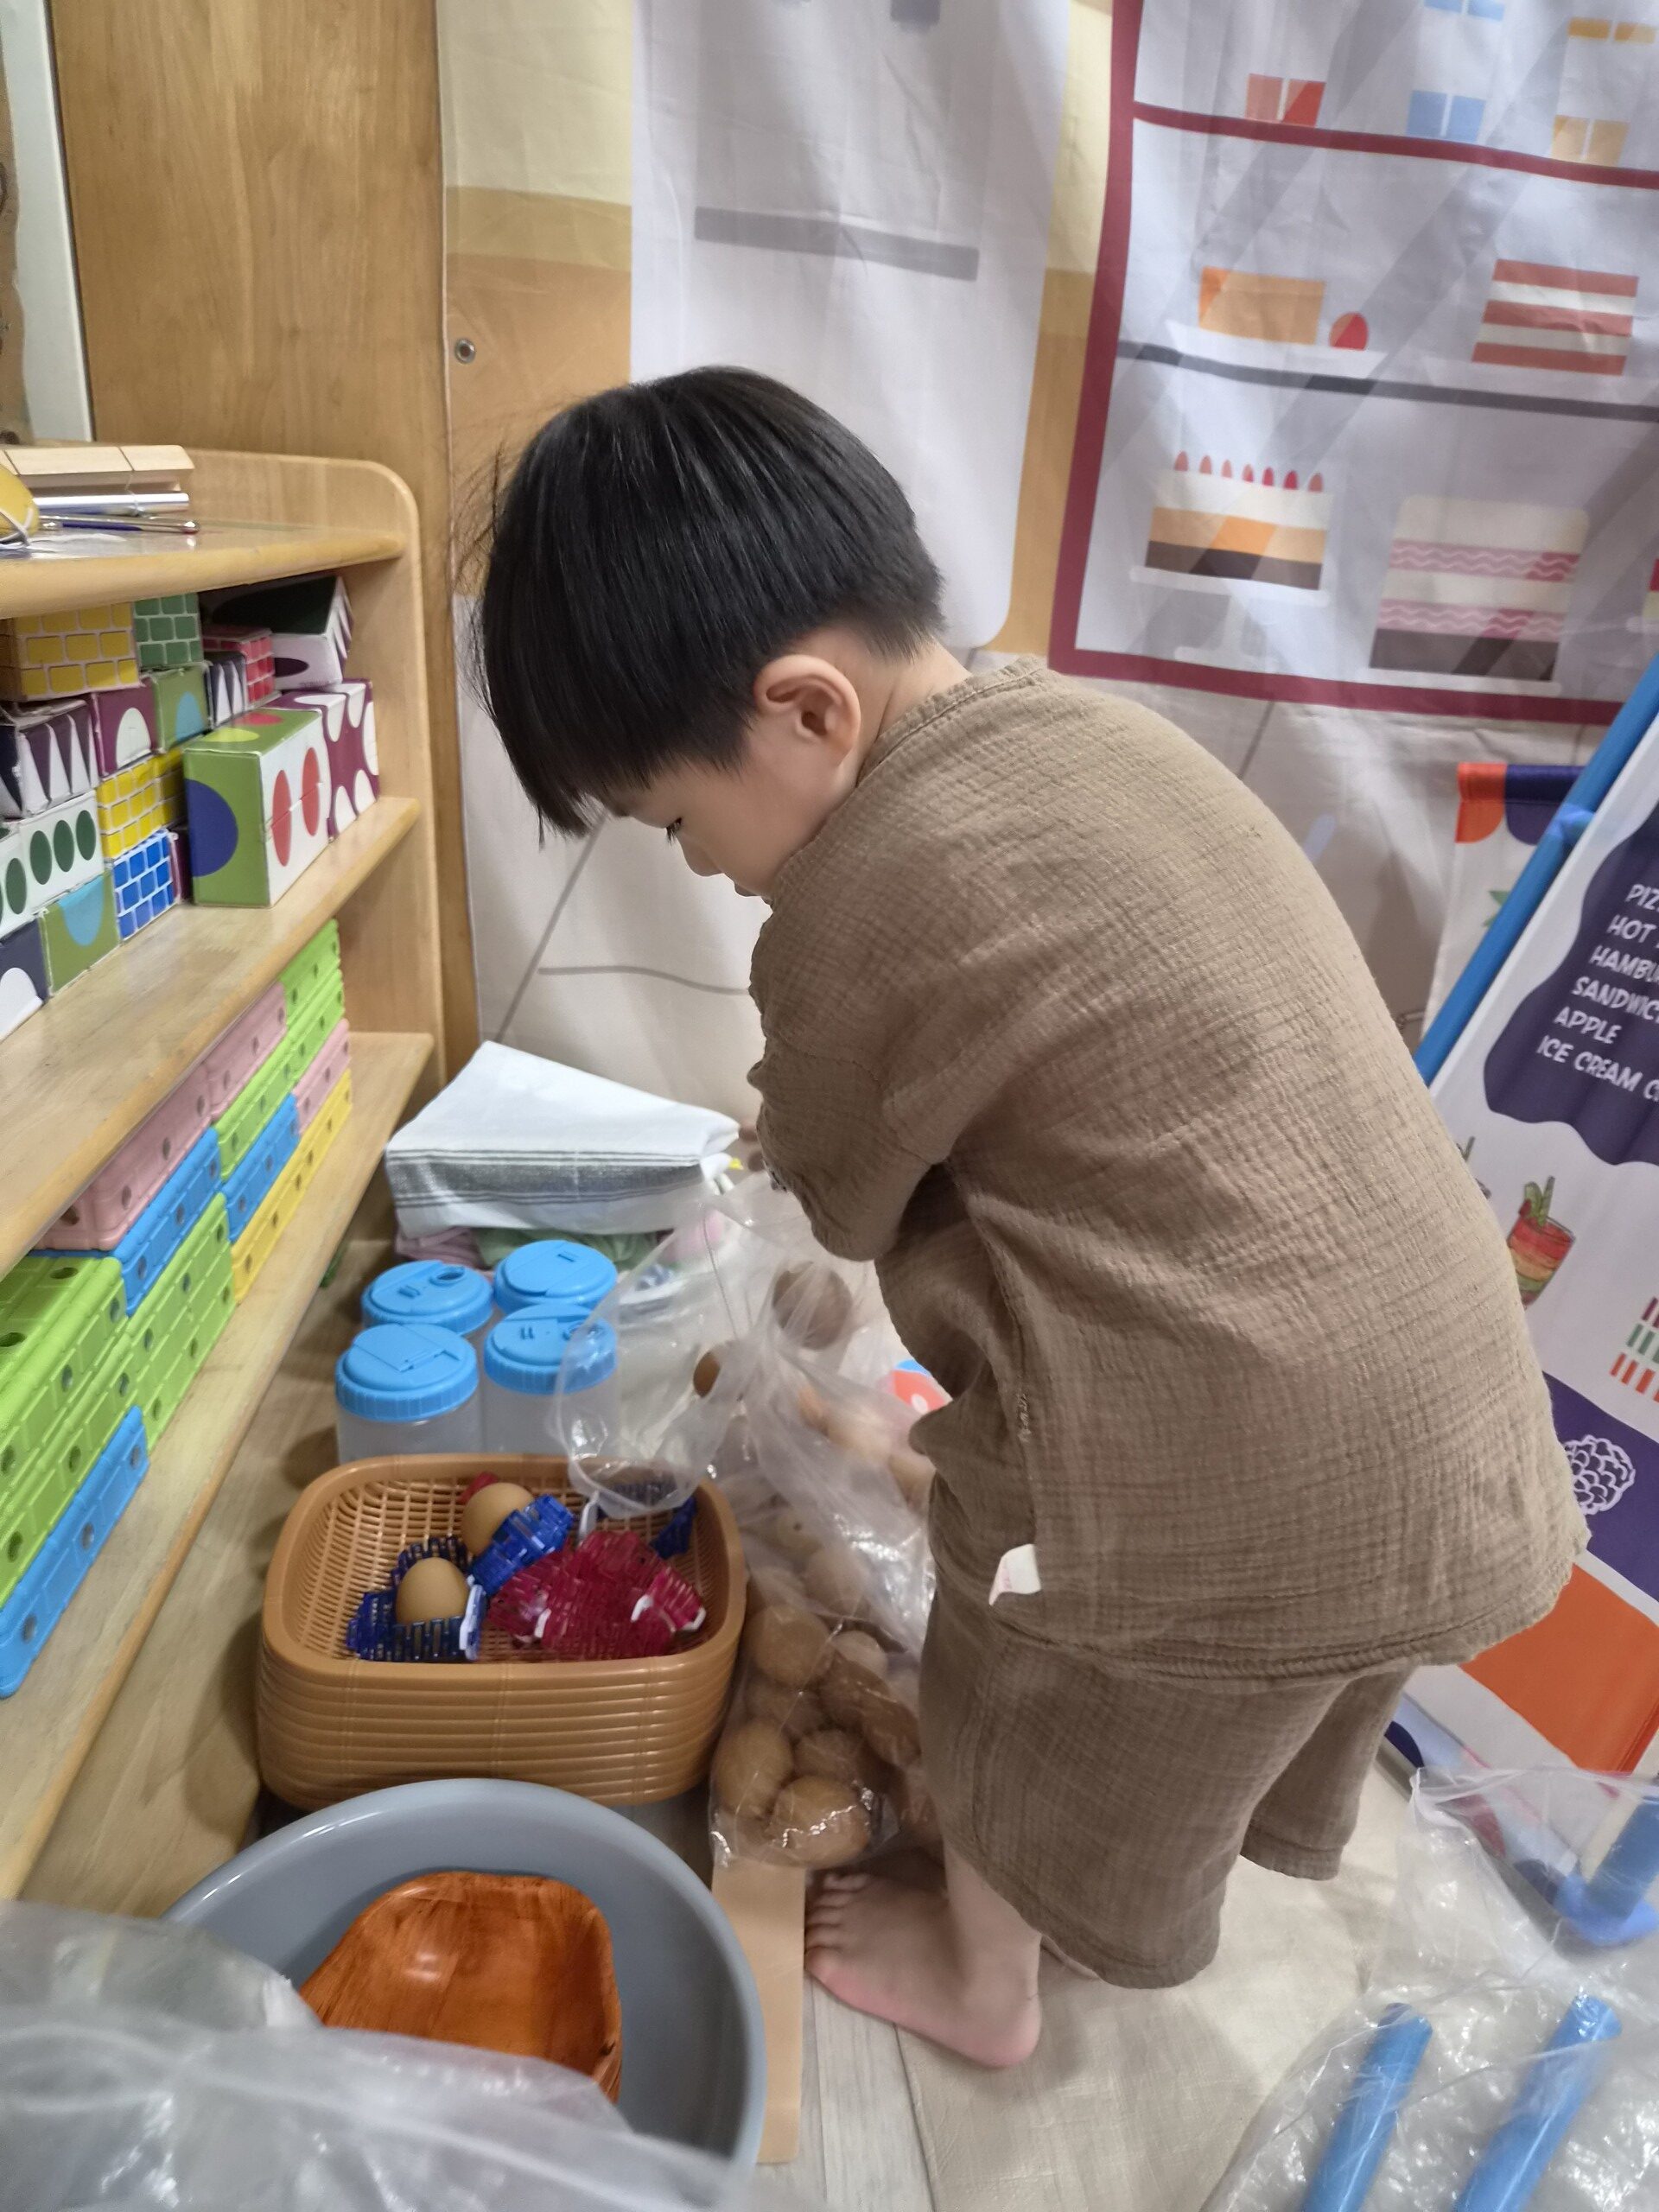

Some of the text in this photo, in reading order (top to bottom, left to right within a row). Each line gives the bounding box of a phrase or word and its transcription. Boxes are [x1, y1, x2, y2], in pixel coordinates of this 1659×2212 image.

[1625, 884, 1659, 912] PIZ
[1606, 914, 1656, 943] HOT
[1588, 945, 1659, 983] HAMBU
[1572, 976, 1659, 1024] SANDWIC
[1554, 1006, 1622, 1044] APPLE
[1536, 1035, 1574, 1063] ICE
[1574, 1051, 1643, 1092] CREAM
